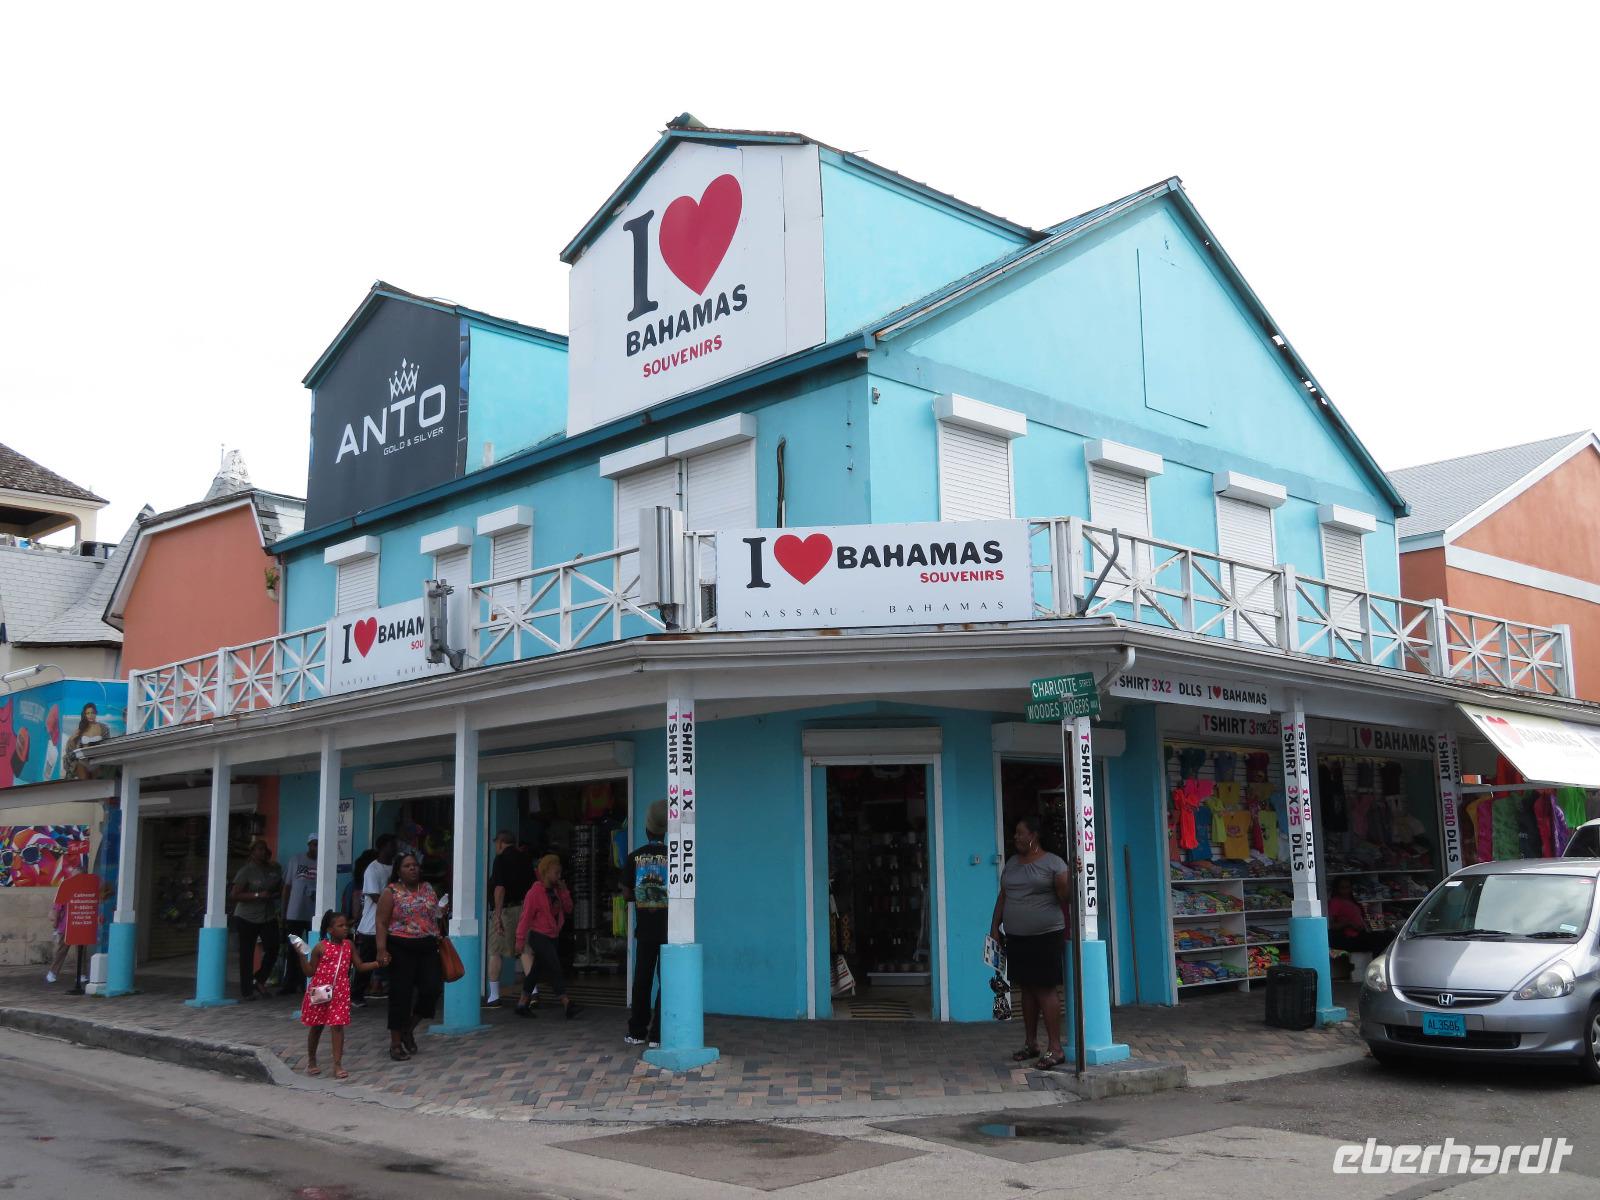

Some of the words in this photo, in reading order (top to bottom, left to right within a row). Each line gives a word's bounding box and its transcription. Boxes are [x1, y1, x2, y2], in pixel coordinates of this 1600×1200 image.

[623, 210, 659, 322] I
[627, 284, 748, 357] BAHAMAS
[643, 335, 723, 378] SOUVENIRS
[335, 384, 446, 464] ANTO
[383, 441, 406, 456] GOLD
[406, 438, 412, 447] &
[413, 426, 444, 445] SILVER
[742, 536, 771, 589] I
[836, 540, 1003, 569] BAHAMAS
[920, 569, 1004, 583] SOUVENIRS
[744, 607, 837, 619] NASSAU
[889, 601, 1004, 614] BAHAMAS
[342, 624, 352, 664] I
[378, 615, 425, 644] BAHAM
[1032, 678, 1077, 698] CHARLOTTE
[1079, 678, 1093, 688] STREET
[1152, 678, 1172, 694] 3X2
[1179, 682, 1202, 697] DLLS
[1223, 688, 1267, 706] BAHAMAS
[1028, 702, 1060, 720] WOODES
[1063, 697, 1090, 715] ROGERS
[1353, 727, 1359, 749] I
[1374, 730, 1436, 753] BAHAMAS
[669, 840, 679, 886] DLLS
[683, 839, 694, 884] DLLS
[1291, 833, 1305, 872] DLLS
[1305, 832, 1315, 870] DLLS
[1446, 829, 1459, 863] DLLS
[1086, 863, 1096, 909] DLLS
